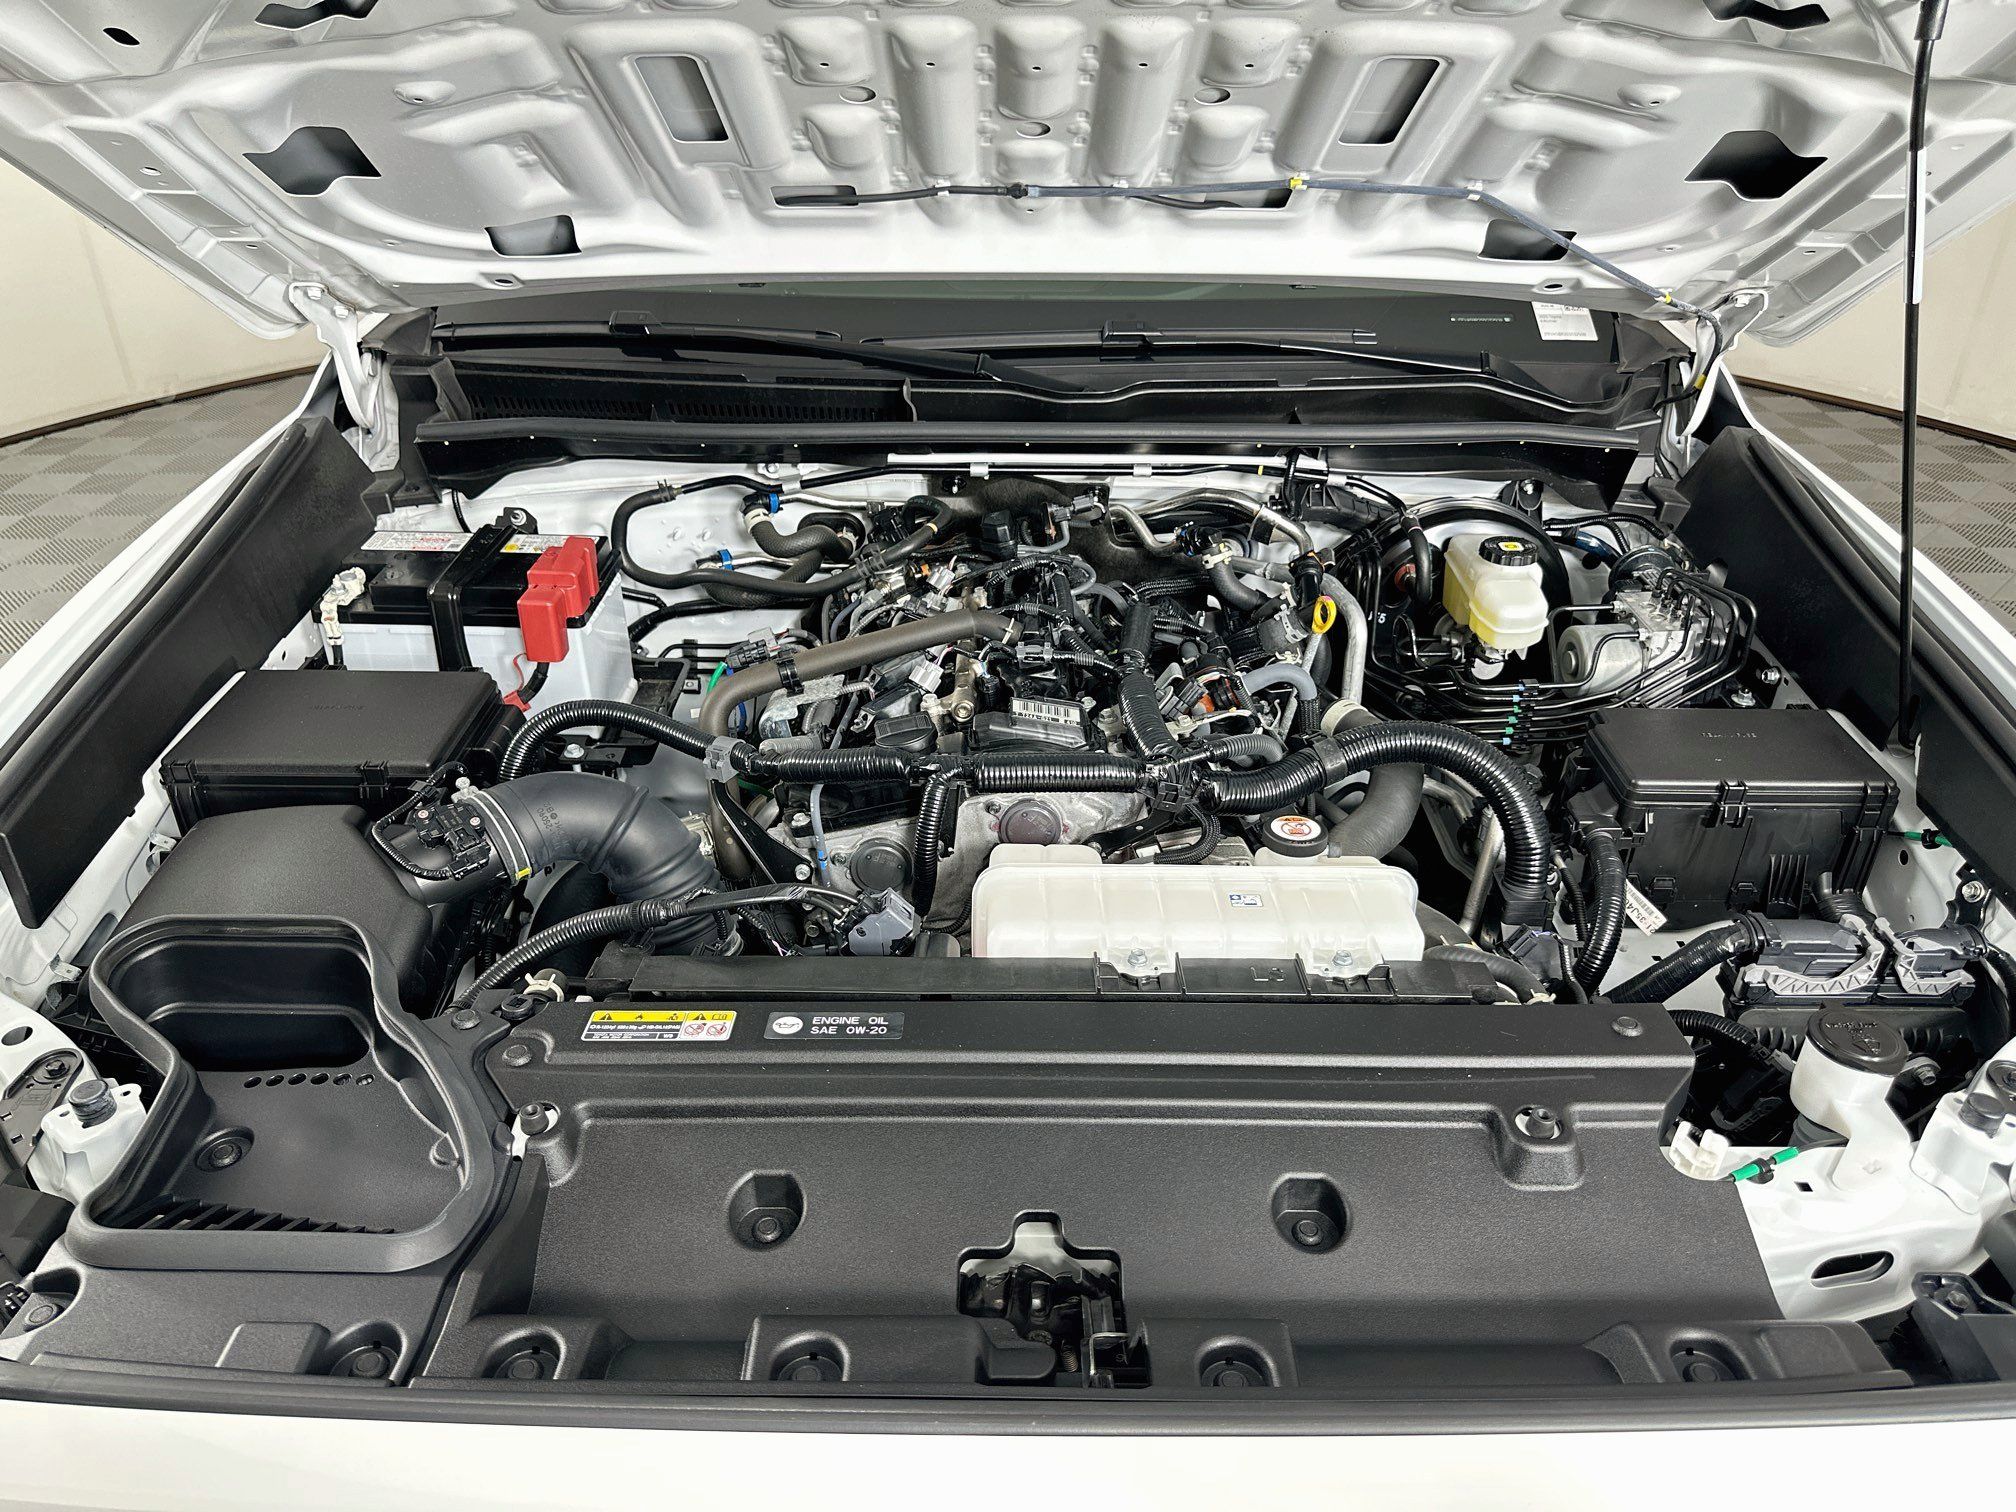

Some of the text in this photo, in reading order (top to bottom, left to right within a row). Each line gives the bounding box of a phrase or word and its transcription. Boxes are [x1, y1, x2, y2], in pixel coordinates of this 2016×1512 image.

[812, 1016, 889, 1025] ENGINE OIL
[810, 1026, 888, 1034] SAE 0W-20
